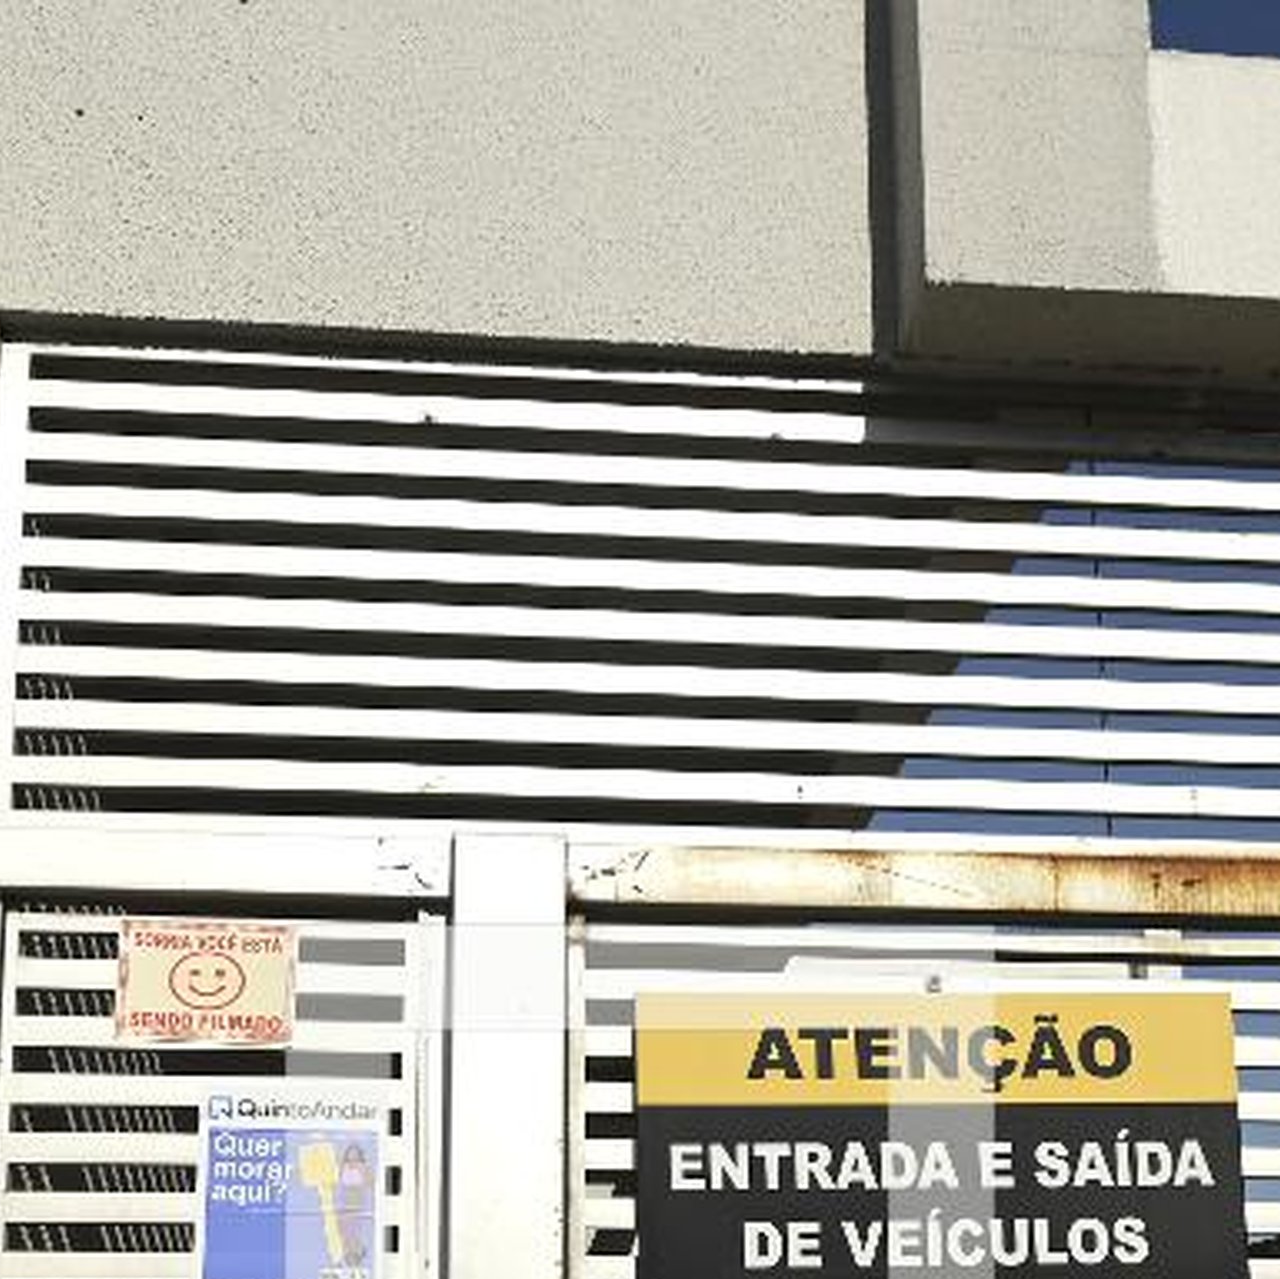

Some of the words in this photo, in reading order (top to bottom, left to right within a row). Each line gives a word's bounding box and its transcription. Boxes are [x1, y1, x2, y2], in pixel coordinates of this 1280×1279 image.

[129, 1011, 193, 1031] SENDO
[198, 1013, 284, 1034] FILMADO
[746, 1014, 1134, 1092] ATENÇÃO
[237, 1097, 377, 1120] QuintoAndar
[214, 1131, 283, 1159] Quer
[213, 1160, 292, 1182] morar
[669, 1140, 959, 1191] ENTRADA
[978, 1141, 1015, 1189] E
[1034, 1128, 1217, 1188] SAÍDA
[210, 1178, 288, 1207] aqui?
[743, 1221, 824, 1270] DE
[841, 1208, 1150, 1269] VEÍCULOS
